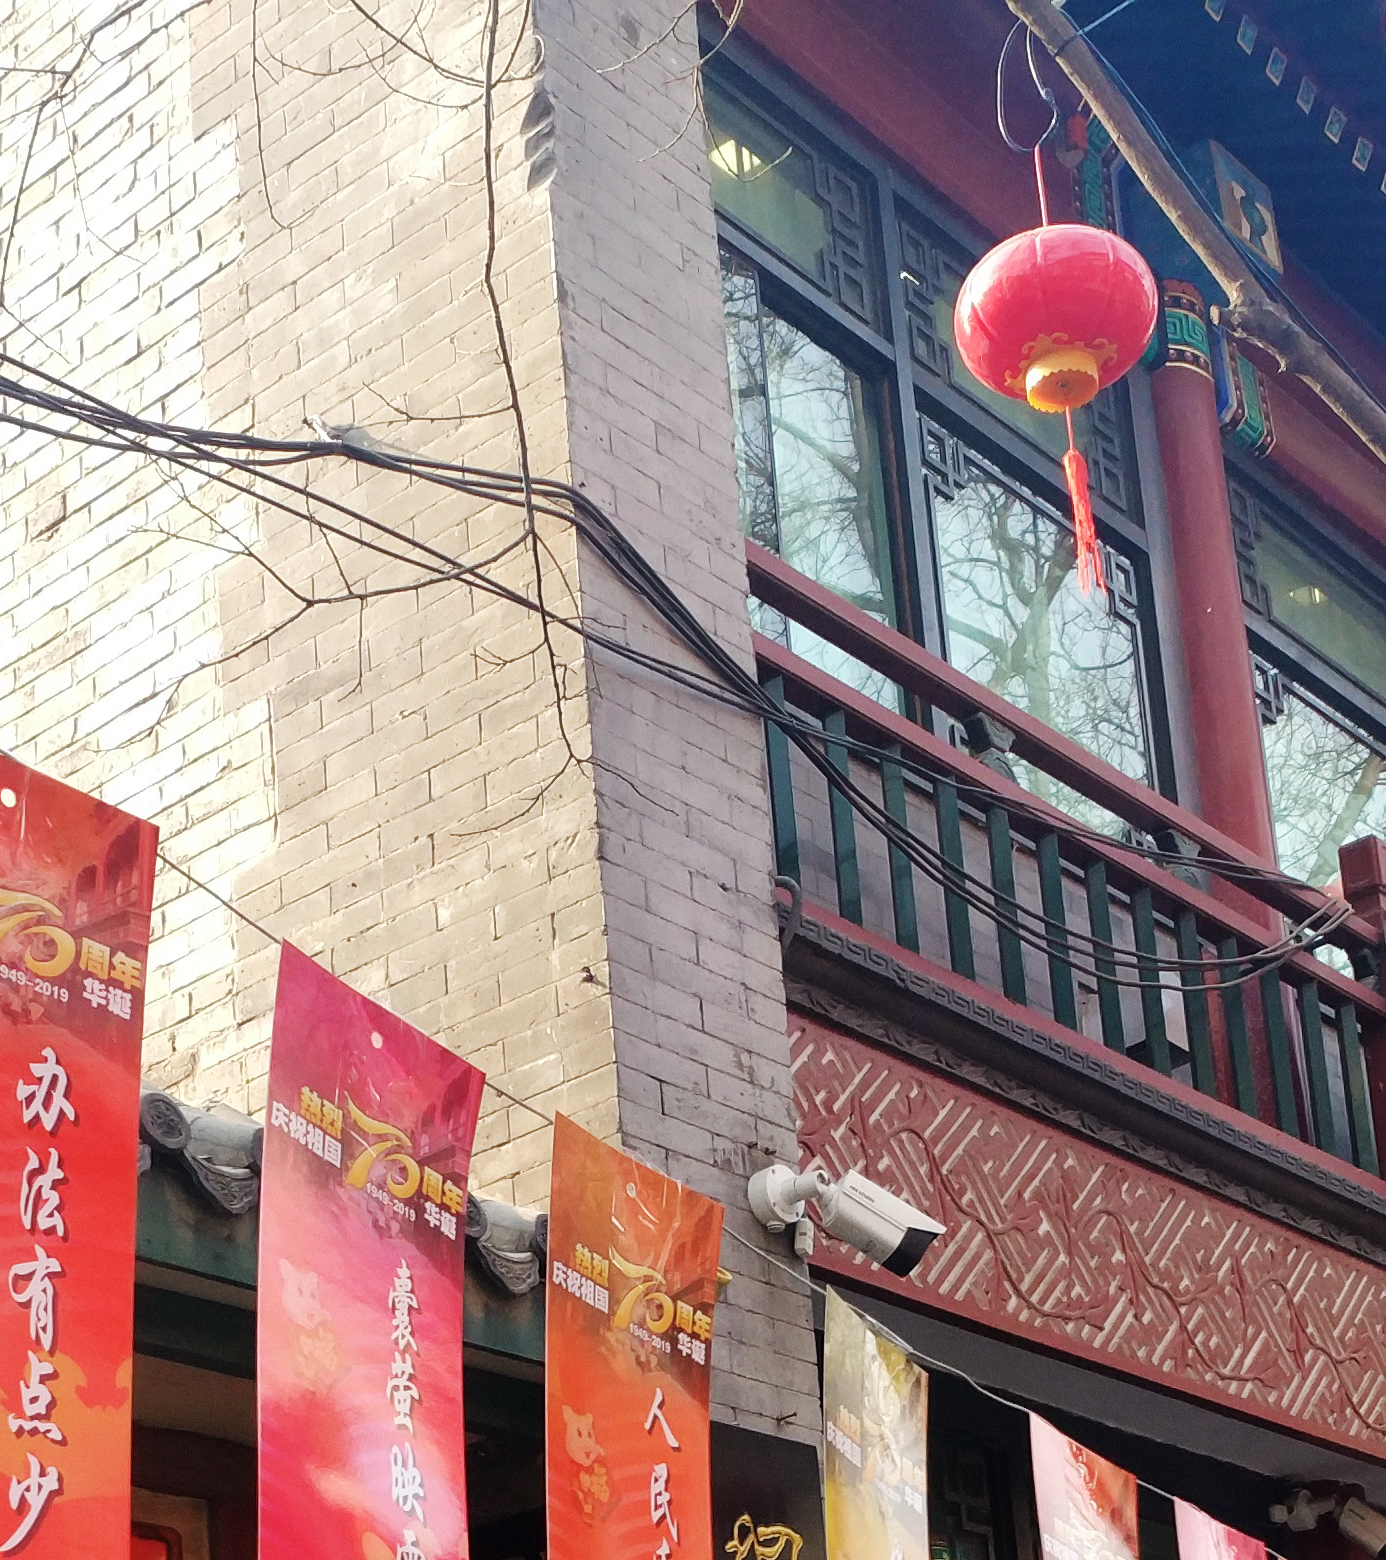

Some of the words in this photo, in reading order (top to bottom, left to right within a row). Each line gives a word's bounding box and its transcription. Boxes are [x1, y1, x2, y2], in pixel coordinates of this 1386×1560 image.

[79, 936, 142, 991] 周年
[82, 978, 132, 1021] 华诞
[271, 1100, 342, 1169] 庆祝祖国
[421, 1165, 464, 1214] 周年
